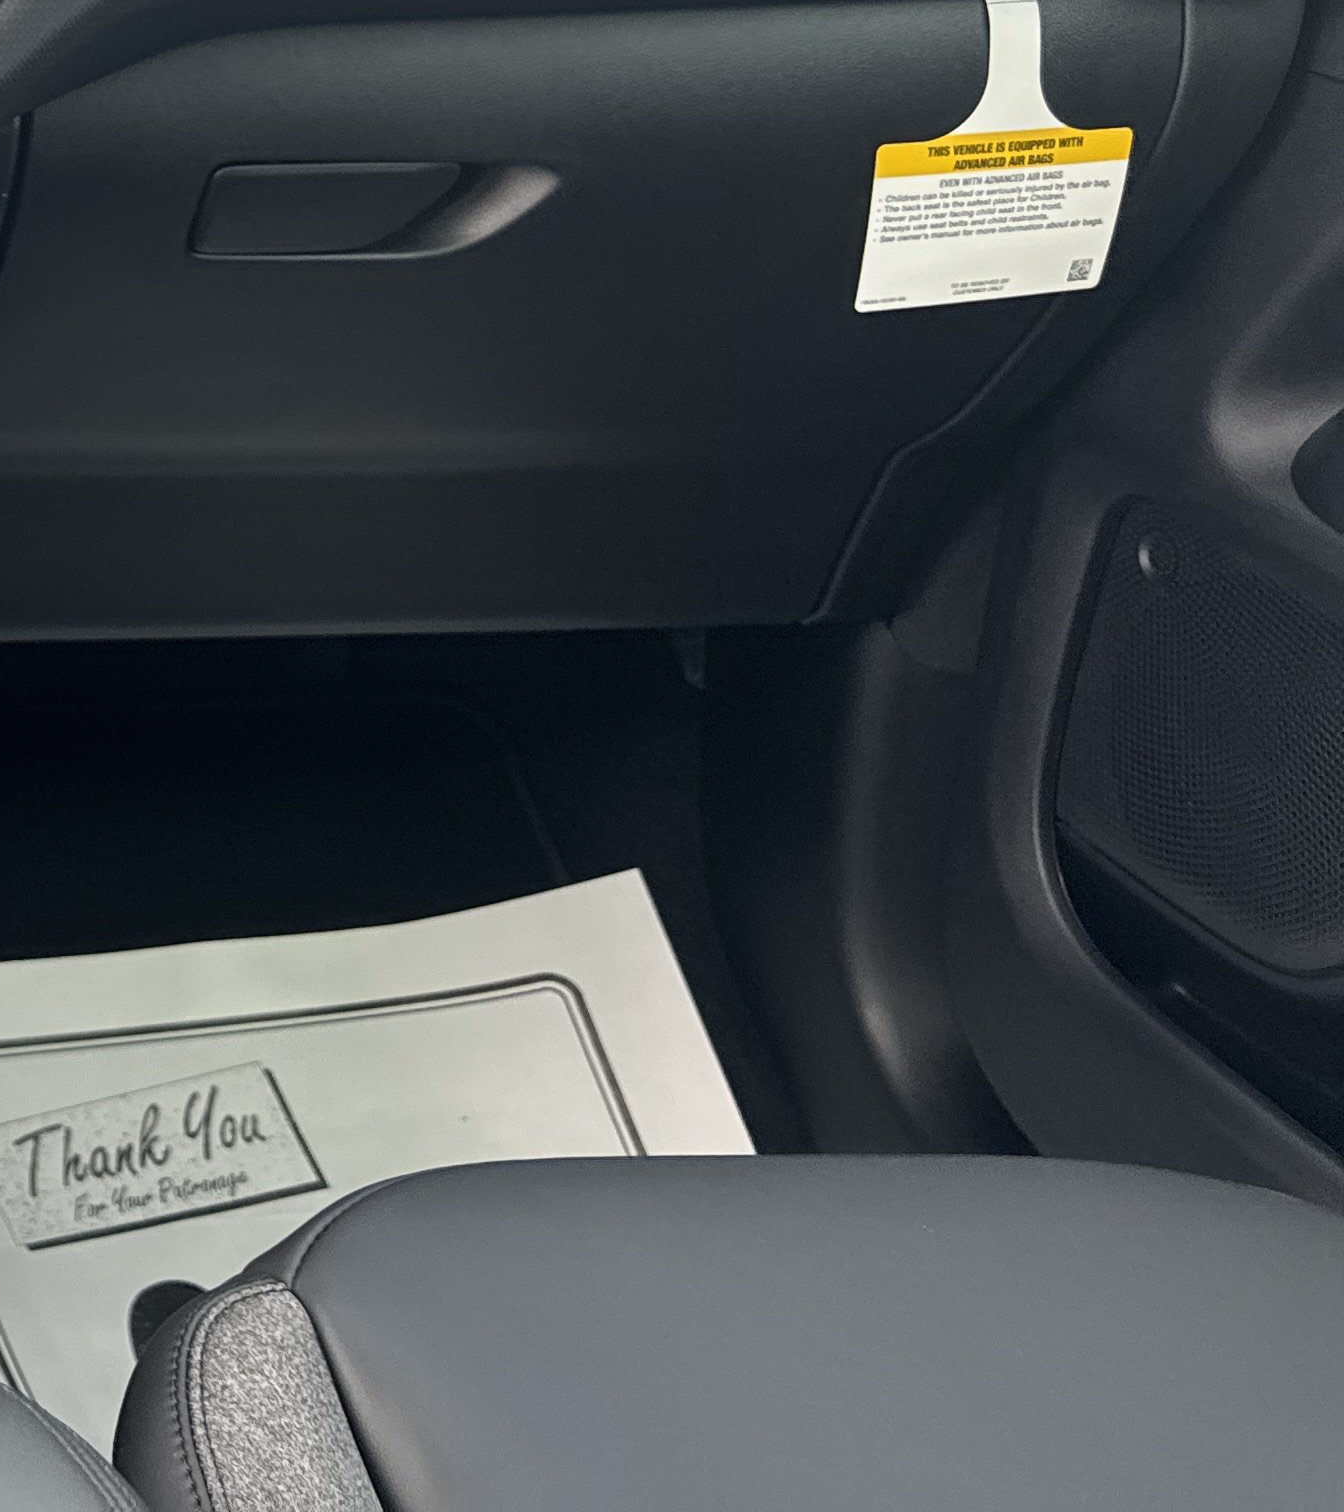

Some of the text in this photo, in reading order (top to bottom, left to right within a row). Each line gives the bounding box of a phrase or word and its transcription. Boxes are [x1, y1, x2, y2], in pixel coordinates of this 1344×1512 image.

[928, 136, 1084, 157] THIS VEHICLE IS EQUIPPED WITH
[954, 153, 1054, 170] ADVANCED AIR BAGS
[939, 170, 1063, 188] EVEN WITH ADVANCED AIR BAGS
[885, 194, 921, 203] Children
[922, 193, 937, 201] can
[1067, 181, 1080, 189] the
[1081, 180, 1093, 188] air
[885, 205, 900, 213] The
[13, 1085, 266, 1197] Thank You
[73, 1171, 249, 1221] For Your Patronage
